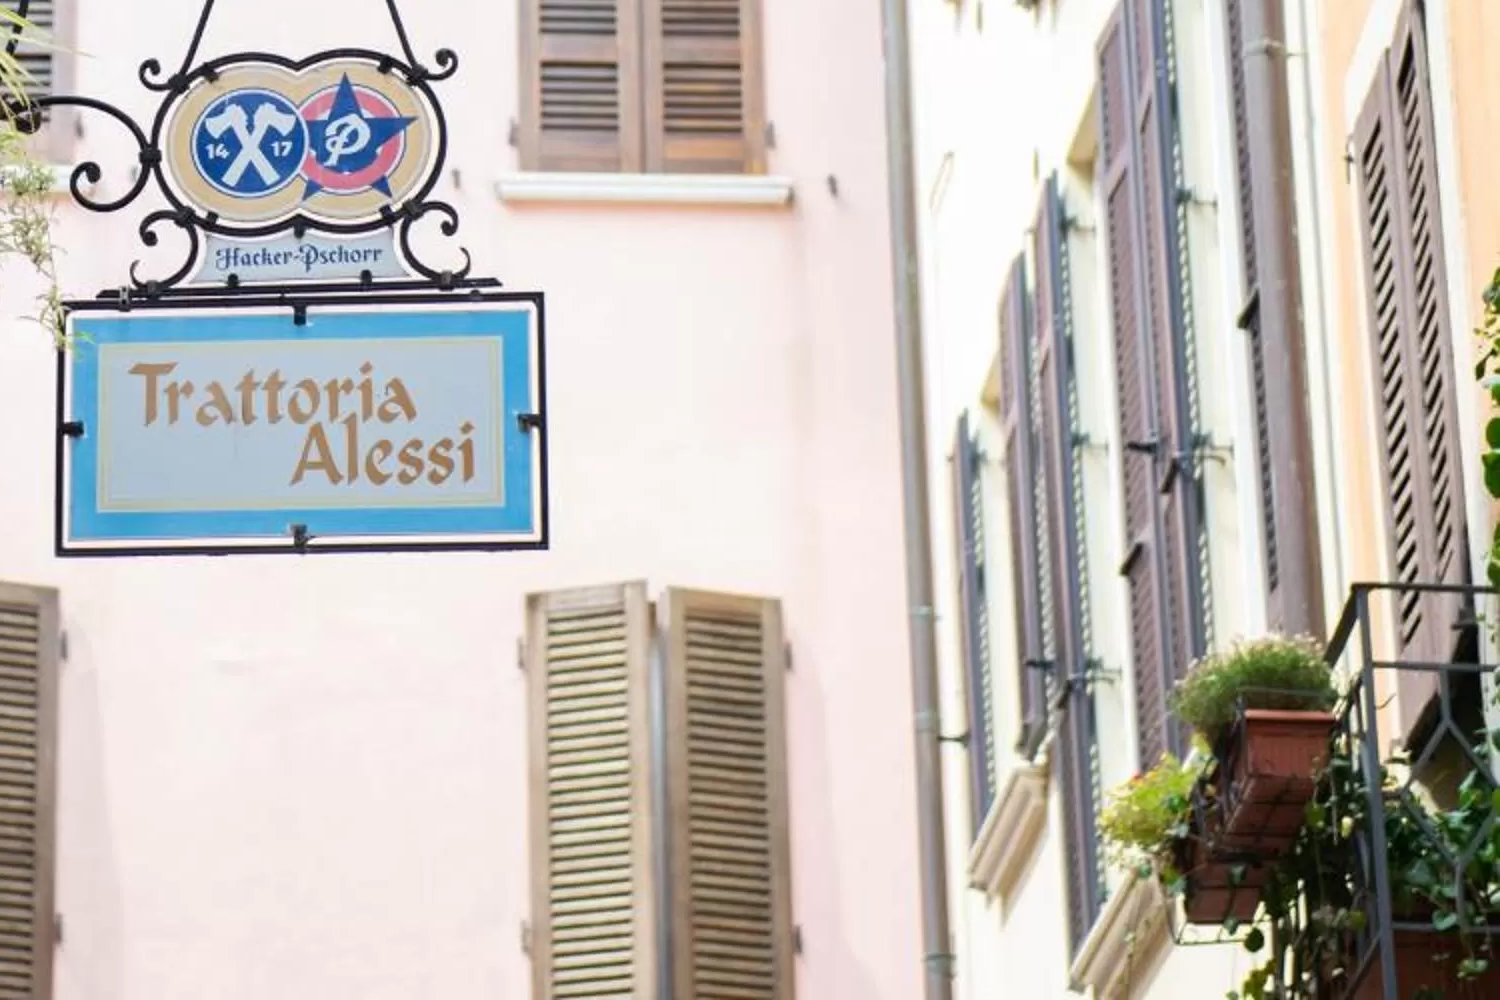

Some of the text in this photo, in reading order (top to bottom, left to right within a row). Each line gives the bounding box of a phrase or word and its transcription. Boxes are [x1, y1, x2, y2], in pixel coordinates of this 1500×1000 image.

[205, 141, 293, 160] 14 17
[216, 243, 383, 272] Hacker-Pschorr
[128, 362, 417, 427] Trattoria
[290, 413, 476, 486] Alessi
